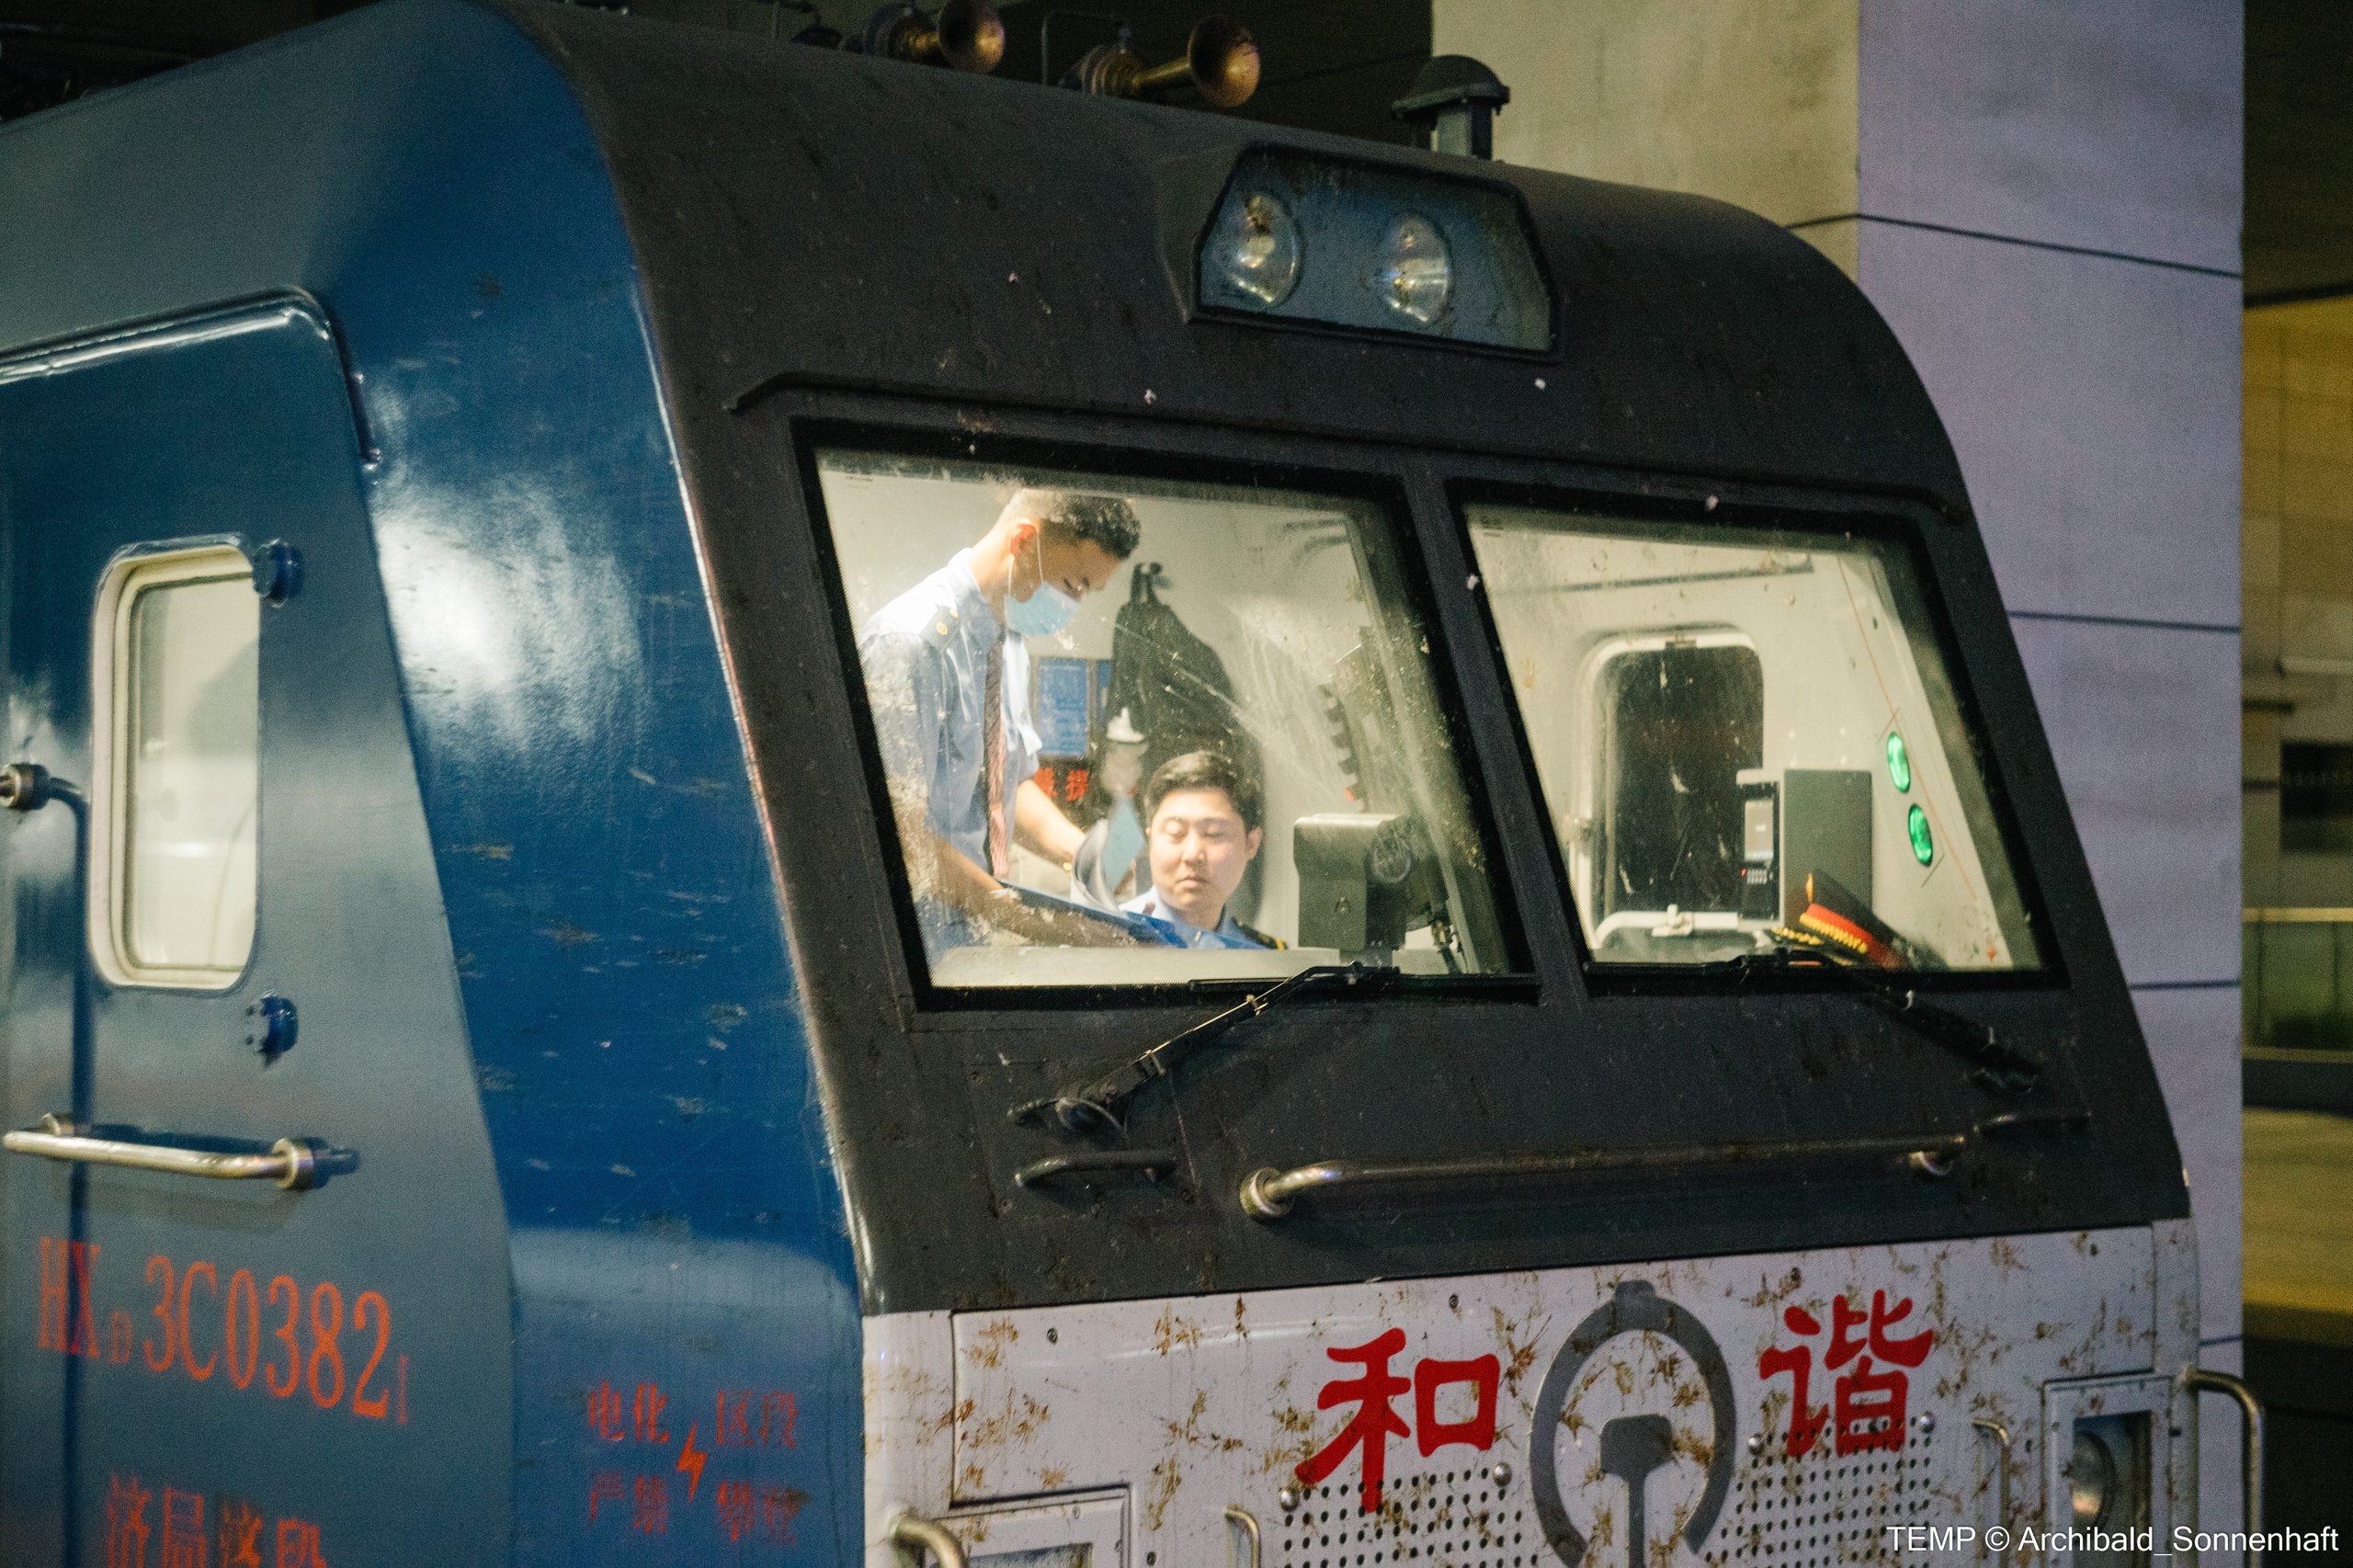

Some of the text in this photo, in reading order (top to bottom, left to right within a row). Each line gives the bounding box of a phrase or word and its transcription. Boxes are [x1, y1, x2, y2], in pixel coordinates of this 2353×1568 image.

[588, 1380, 670, 1443] 电化
[1294, 1290, 1934, 1513] 和 谐
